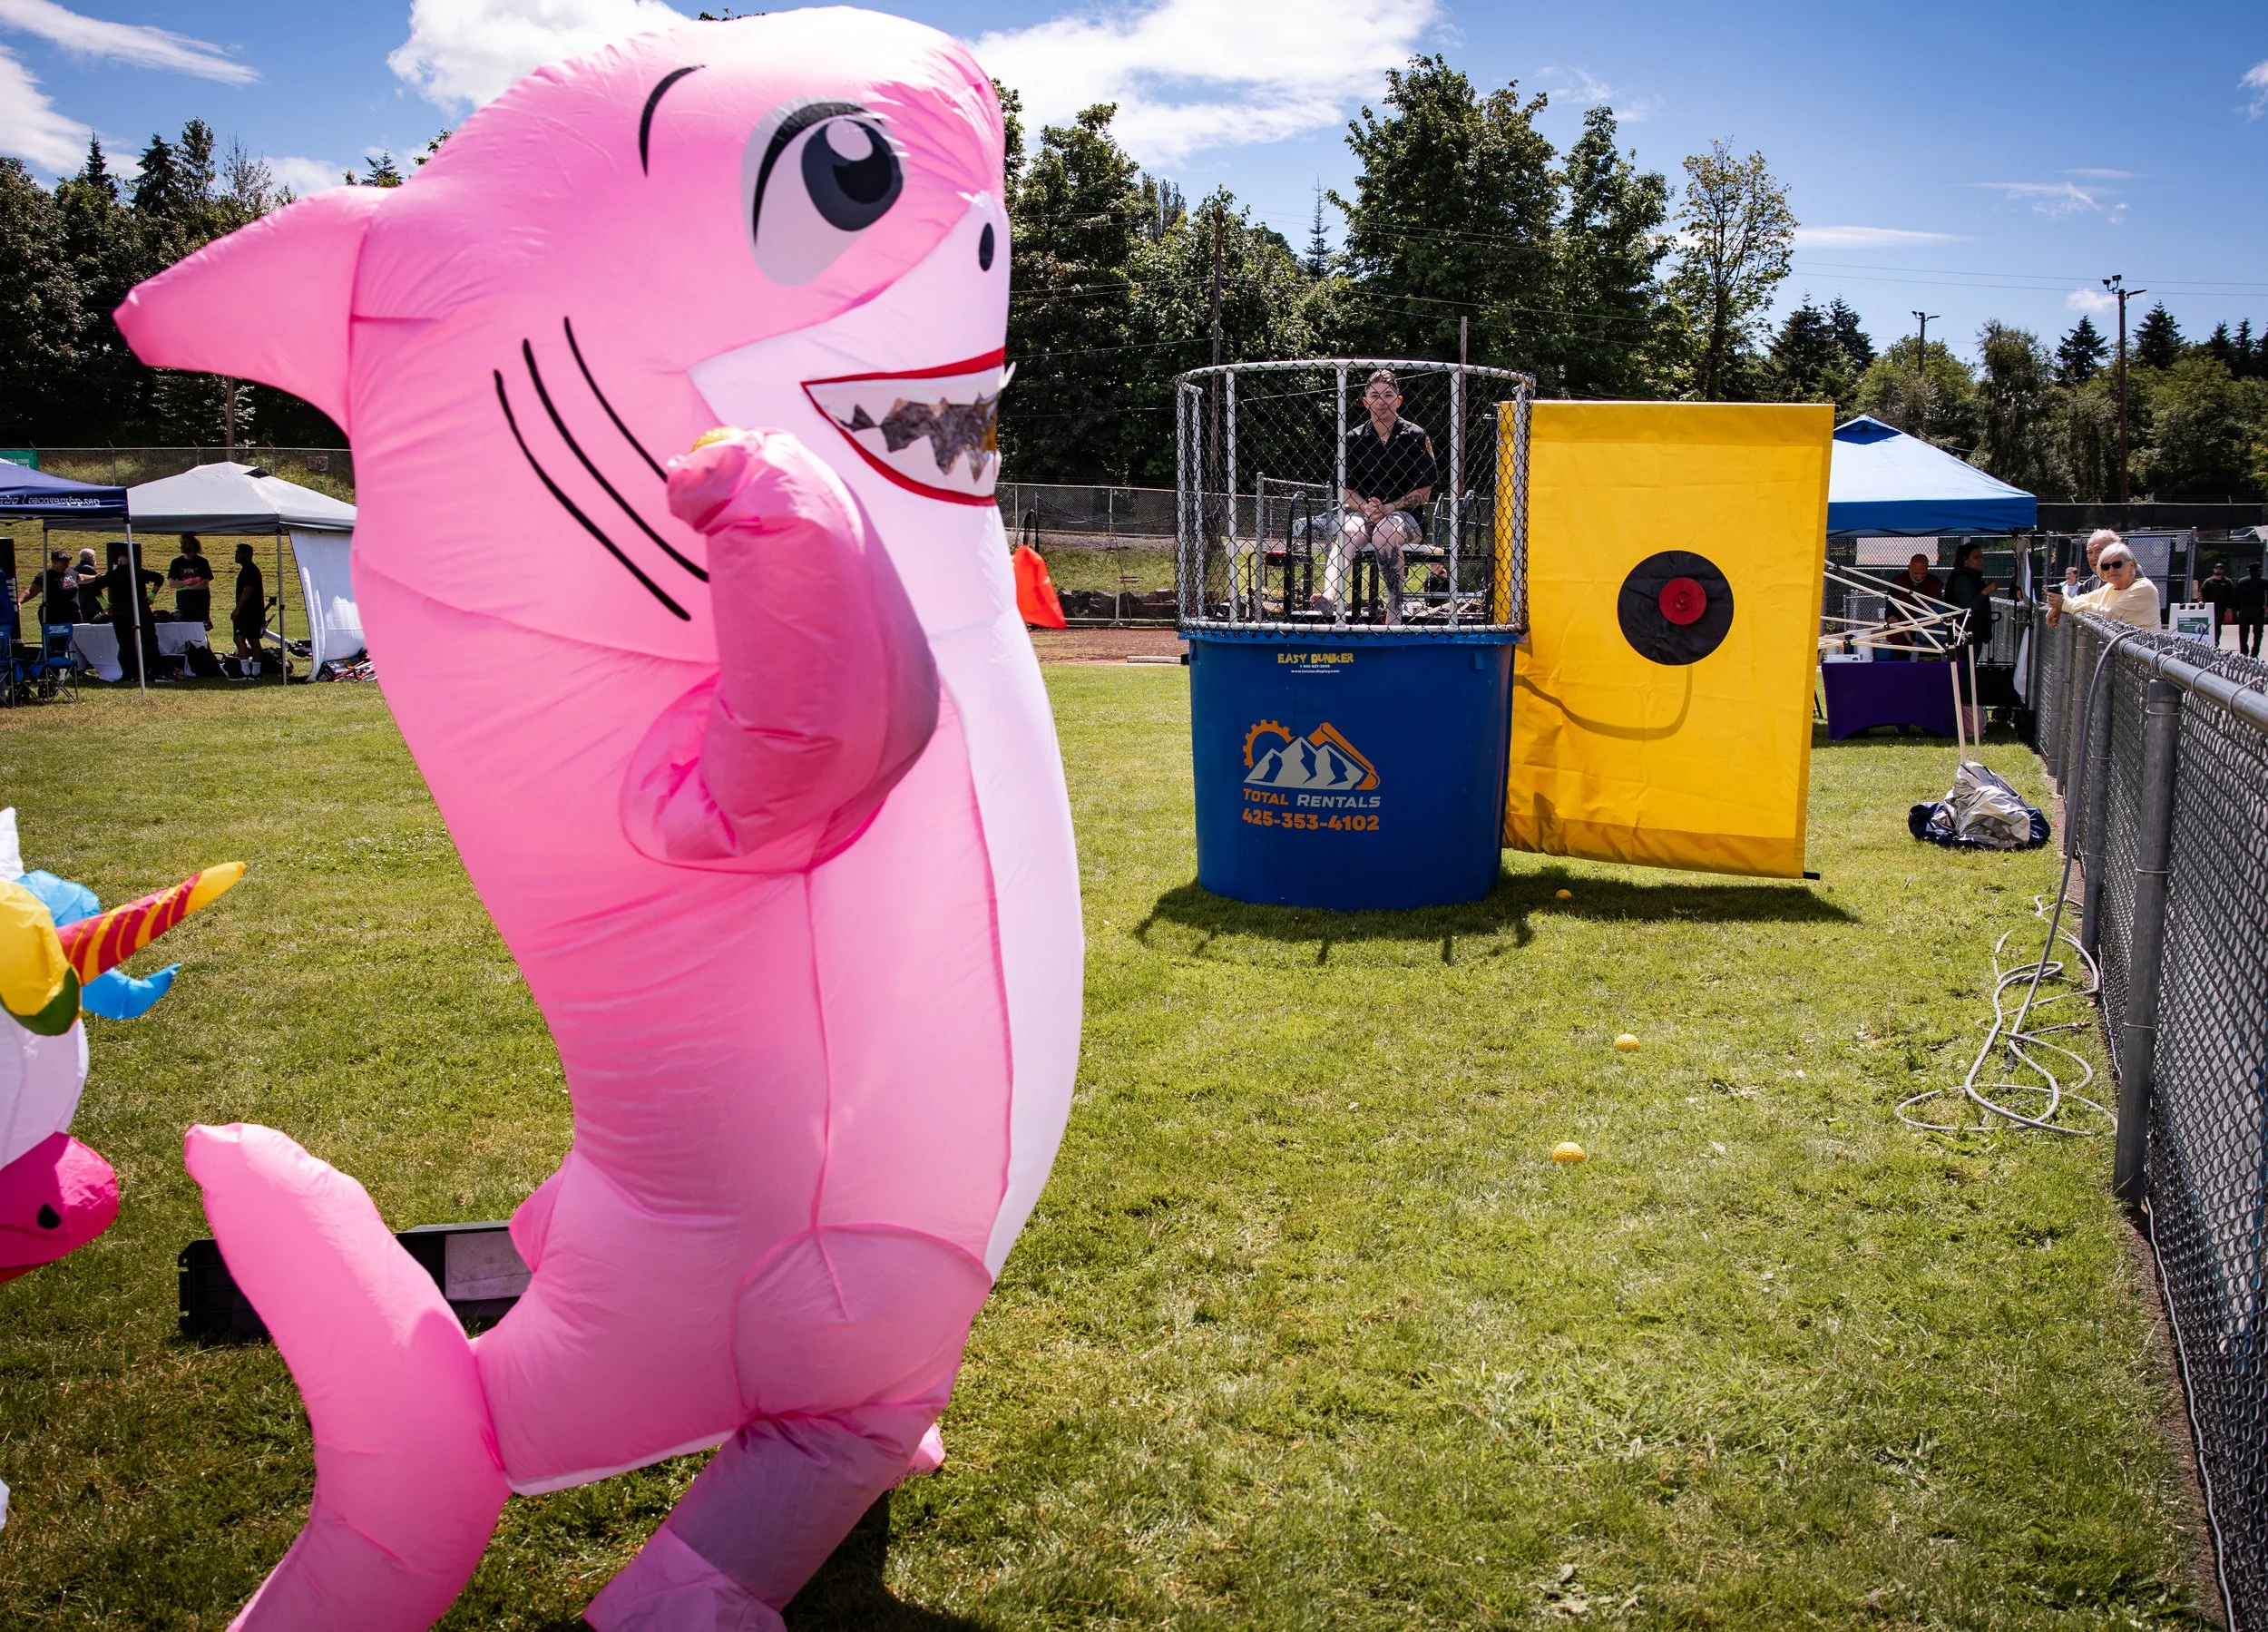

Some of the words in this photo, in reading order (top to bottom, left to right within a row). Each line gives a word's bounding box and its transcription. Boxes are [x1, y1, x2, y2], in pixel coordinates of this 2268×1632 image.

[1277, 653, 1307, 664] EASY
[1311, 653, 1354, 664] DUNKER
[1243, 787, 1289, 806] TOTAL
[1296, 794, 1381, 807] RENTALS
[1242, 807, 1380, 831] 425-353-4102
